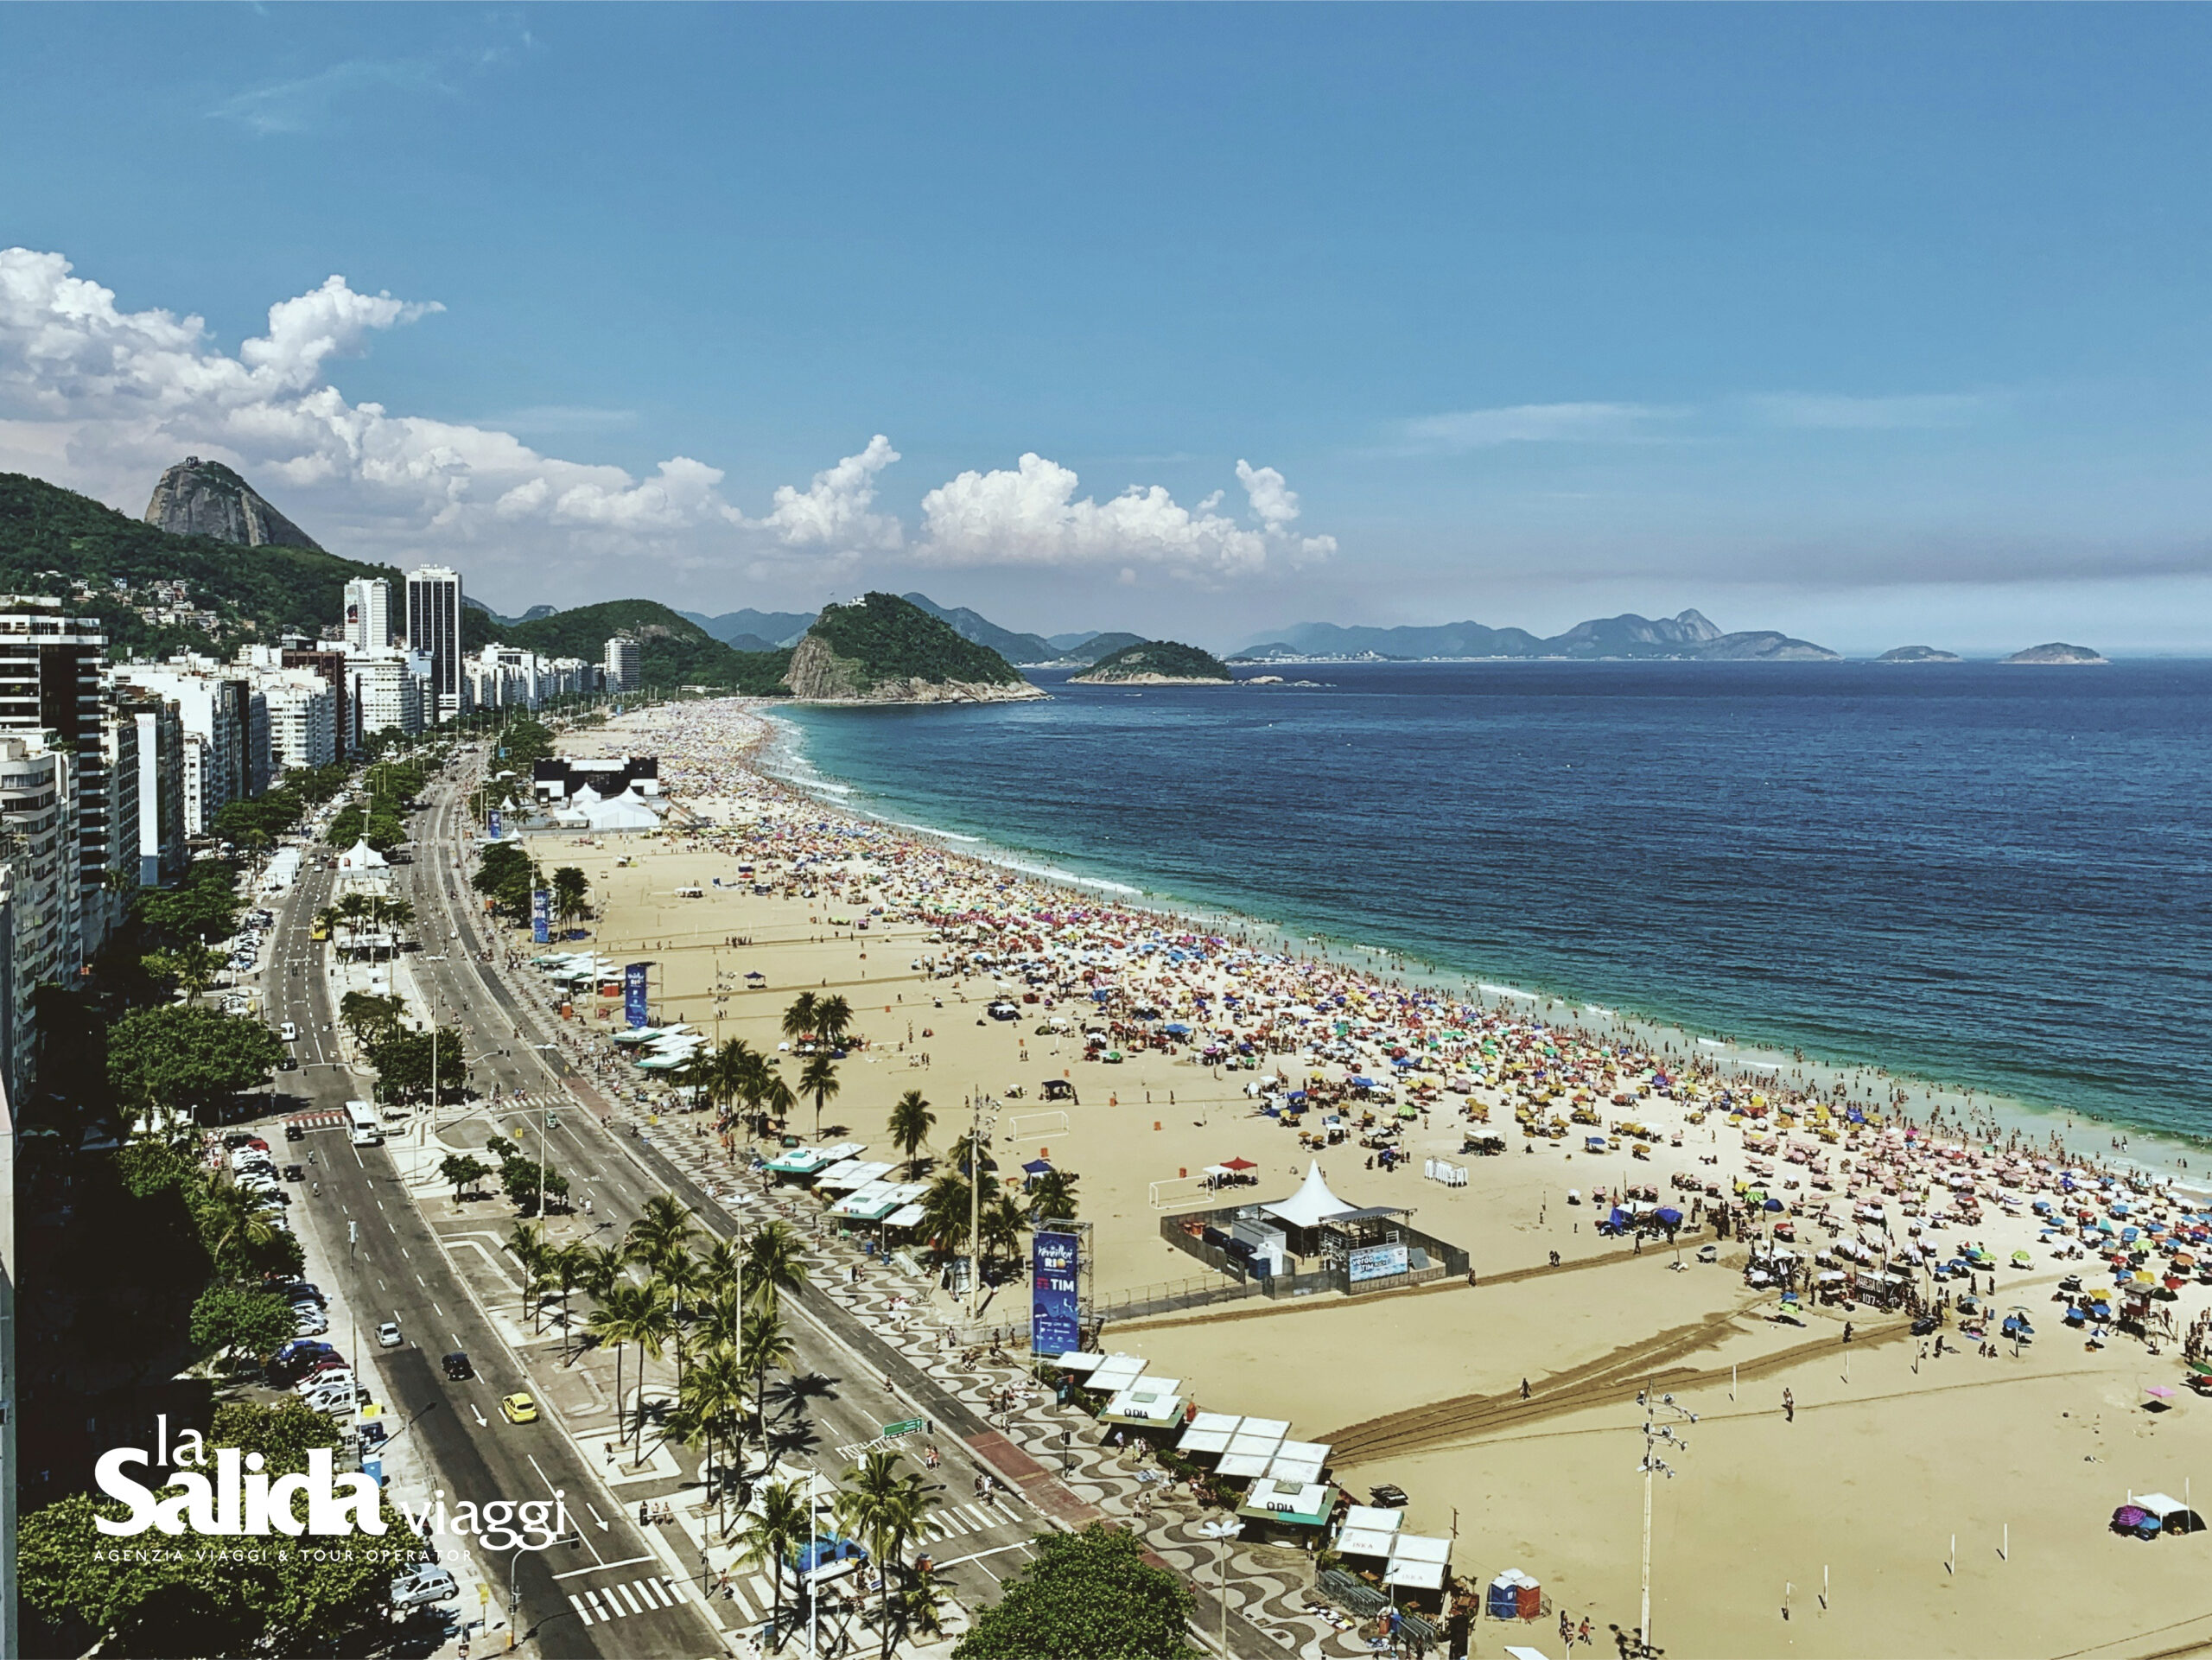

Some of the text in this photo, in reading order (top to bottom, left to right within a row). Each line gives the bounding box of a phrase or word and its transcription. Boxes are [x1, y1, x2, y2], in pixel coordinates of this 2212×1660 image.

[1045, 1257, 1066, 1269] RIO
[1051, 1278, 1075, 1292] TIM
[1862, 1293, 1876, 1305] 107
